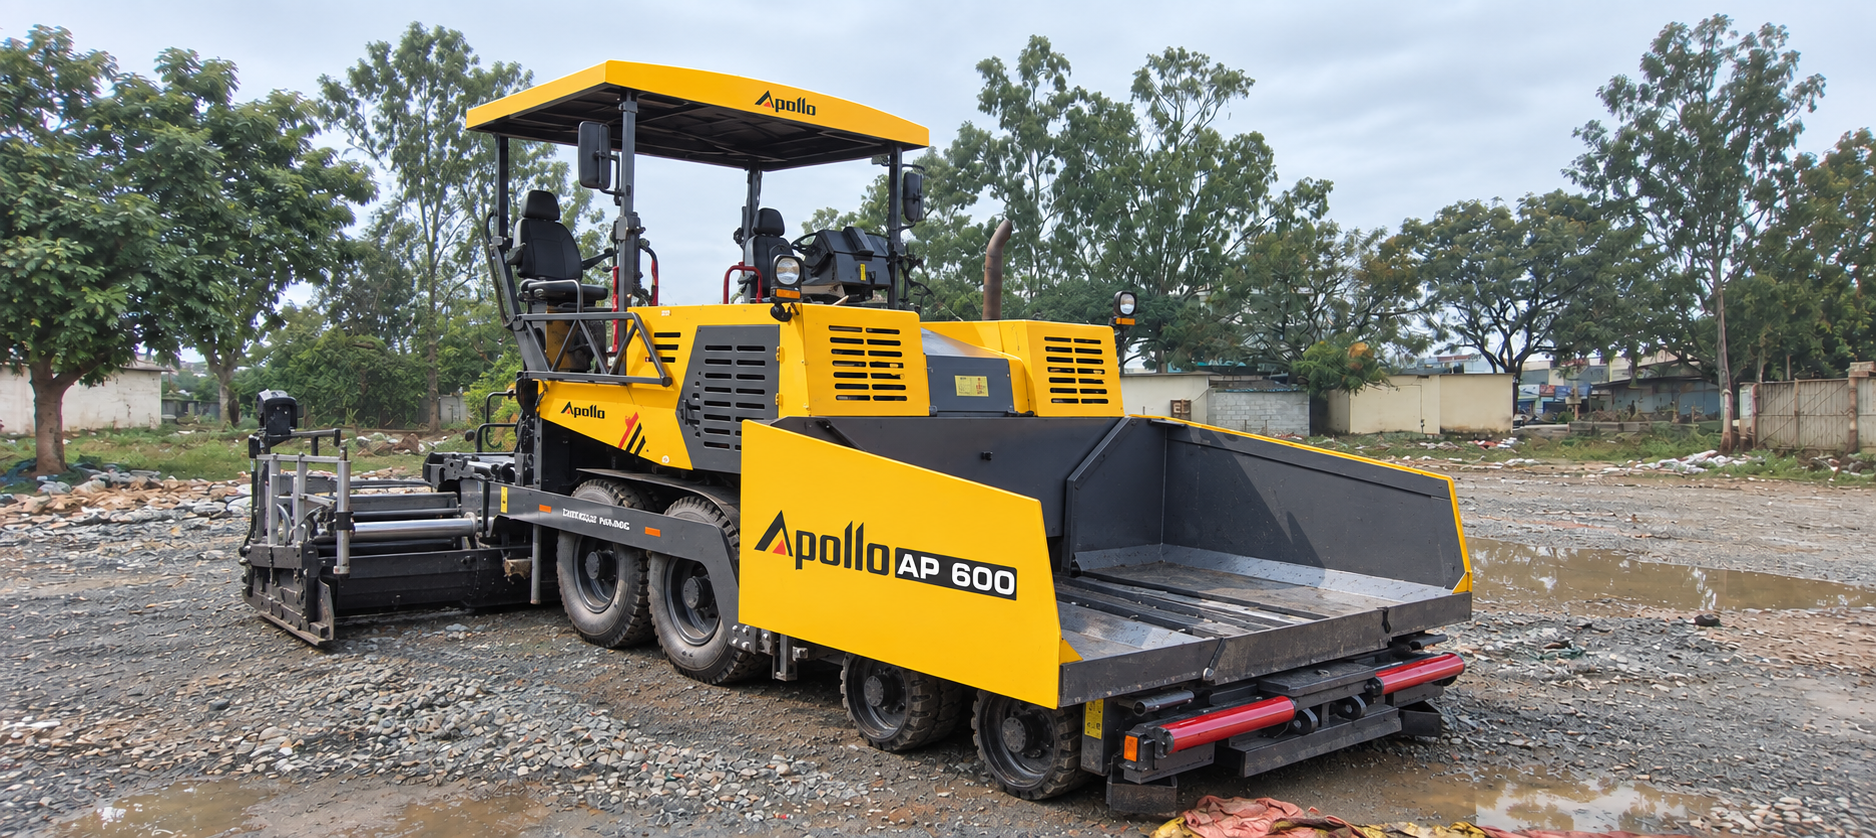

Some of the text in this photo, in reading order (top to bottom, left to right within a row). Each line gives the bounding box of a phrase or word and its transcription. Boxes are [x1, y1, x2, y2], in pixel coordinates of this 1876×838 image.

[755, 90, 816, 116] Apollo
[561, 401, 606, 420] Apollo
[754, 510, 1015, 596] Apollo AP 600
